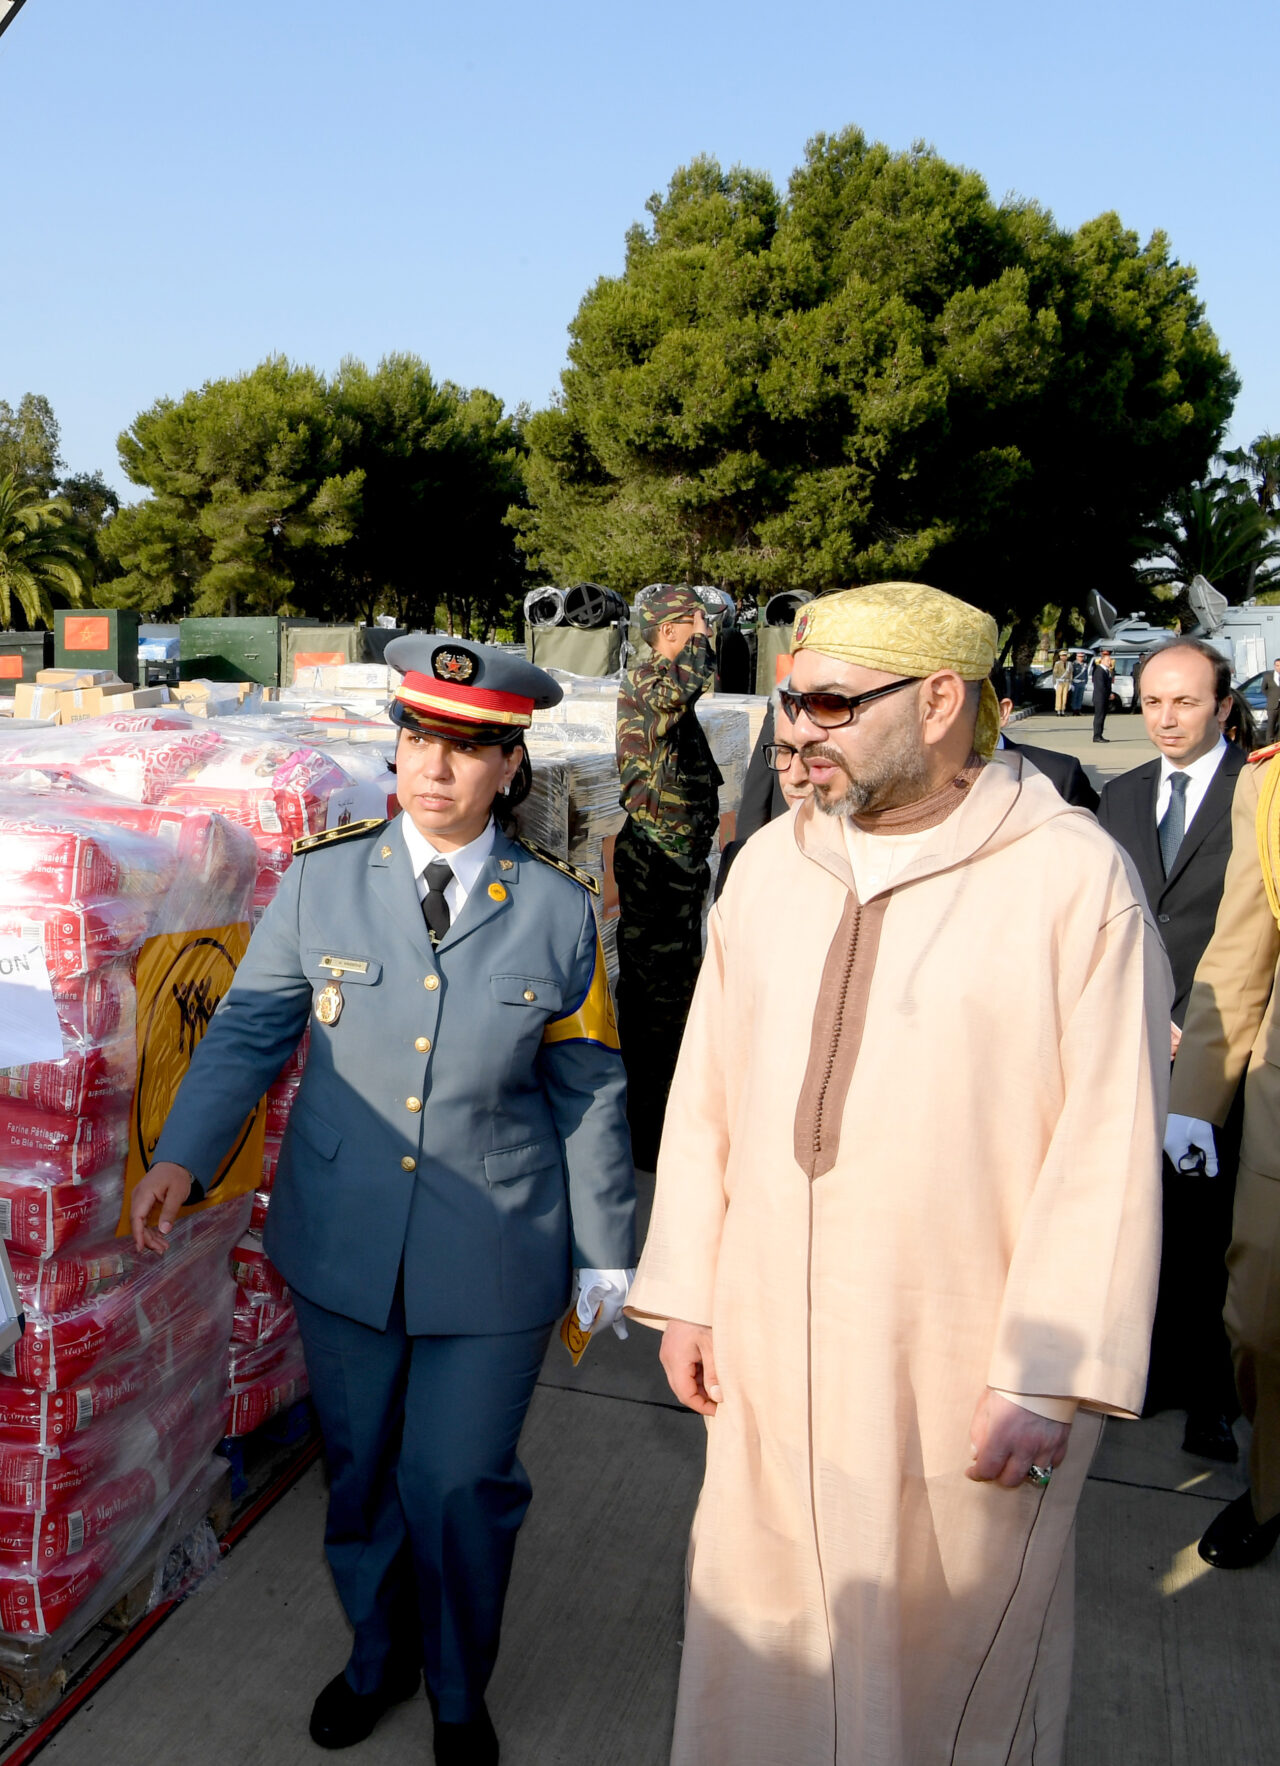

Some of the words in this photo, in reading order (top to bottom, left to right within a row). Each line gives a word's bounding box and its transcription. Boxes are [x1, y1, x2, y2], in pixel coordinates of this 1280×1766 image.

[7, 1122, 29, 1134] Farine
[31, 1126, 69, 1141] Pâtissière
[11, 1136, 21, 1145] De
[35, 1140, 60, 1151] Tendre
